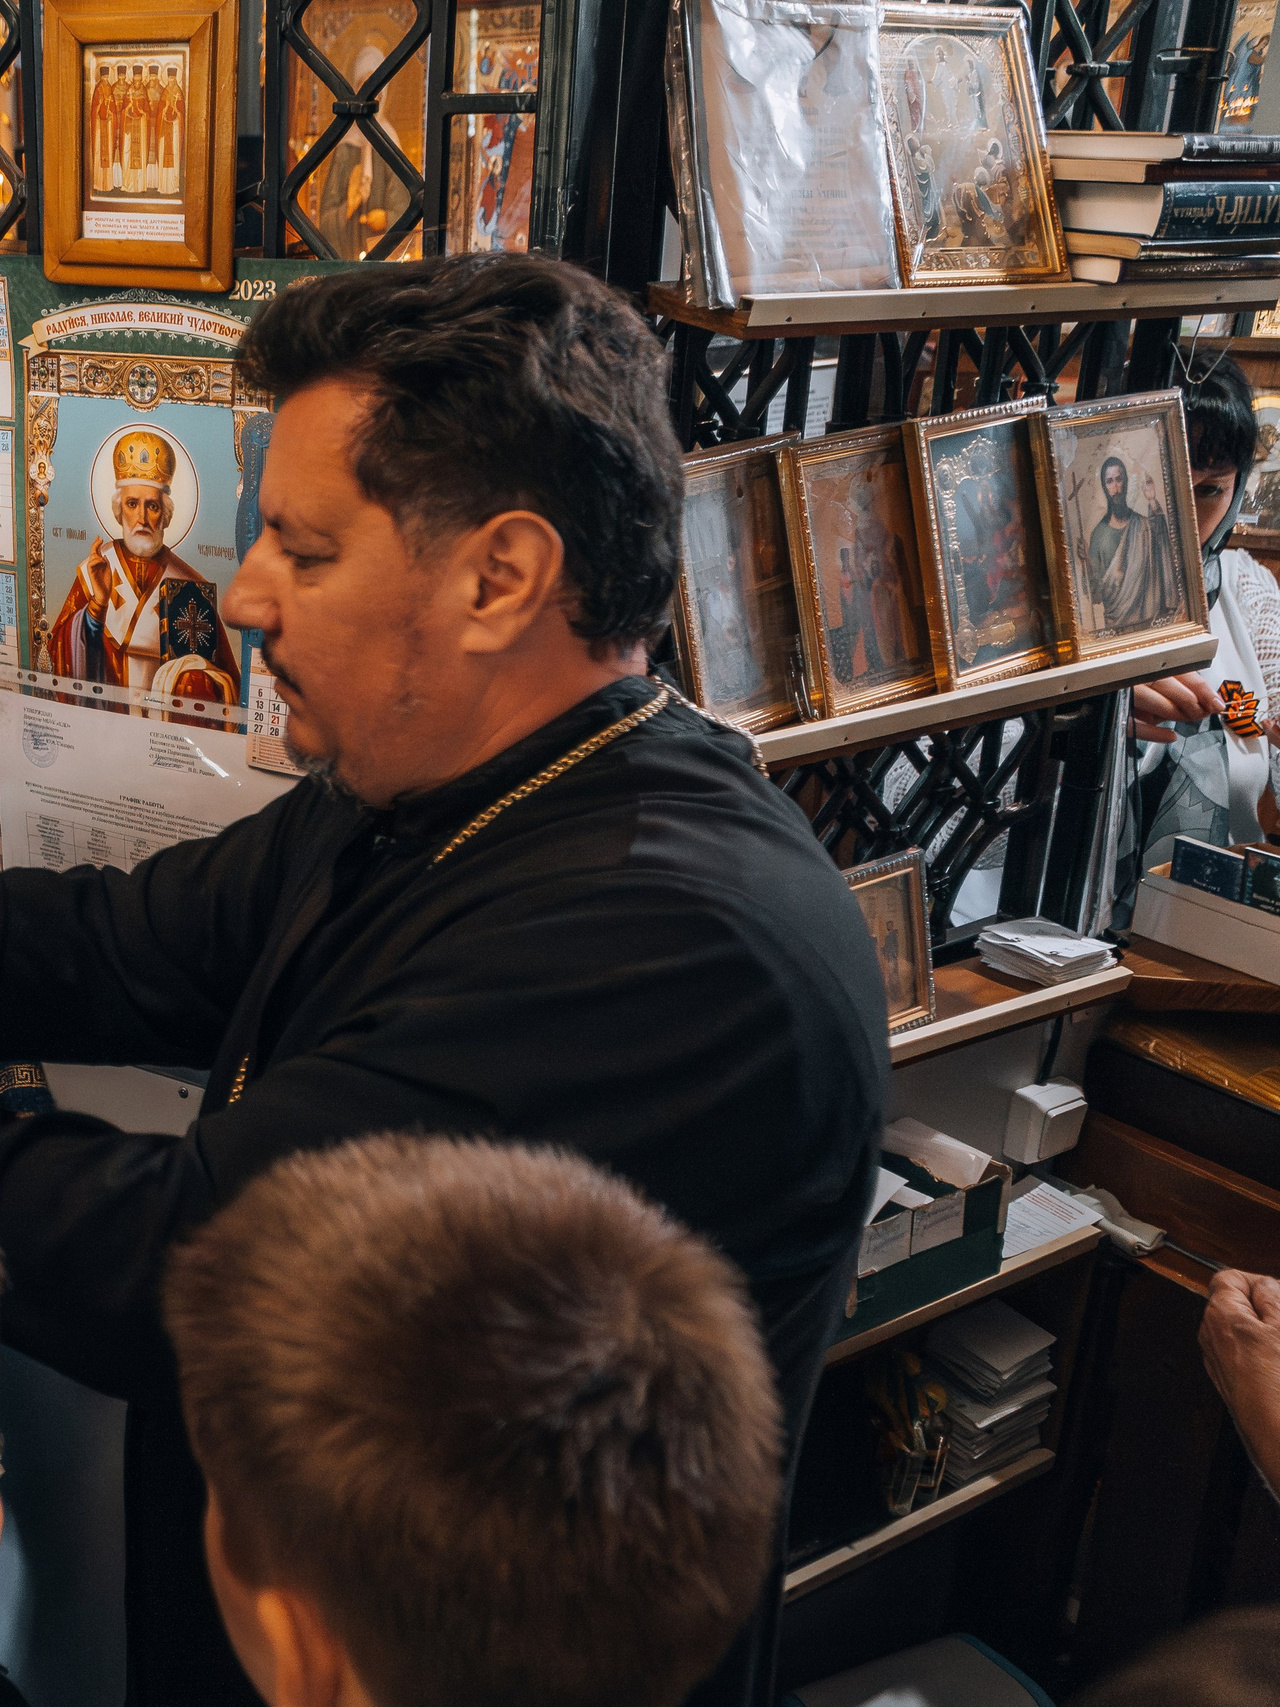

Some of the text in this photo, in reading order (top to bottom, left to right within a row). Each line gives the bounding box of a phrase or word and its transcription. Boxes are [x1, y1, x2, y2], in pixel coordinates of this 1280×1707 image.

[229, 280, 277, 300] 2023
[46, 315, 89, 336] РАДУЙСЯ,
[90, 310, 136, 325] НИКОЛАЕ,
[138, 311, 184, 325] ВЕЛИКИЙ
[258, 688, 262, 697] 6
[256, 700, 280, 712] 13 14
[254, 712, 280, 724] 20 21
[254, 724, 279, 736] 27 28
